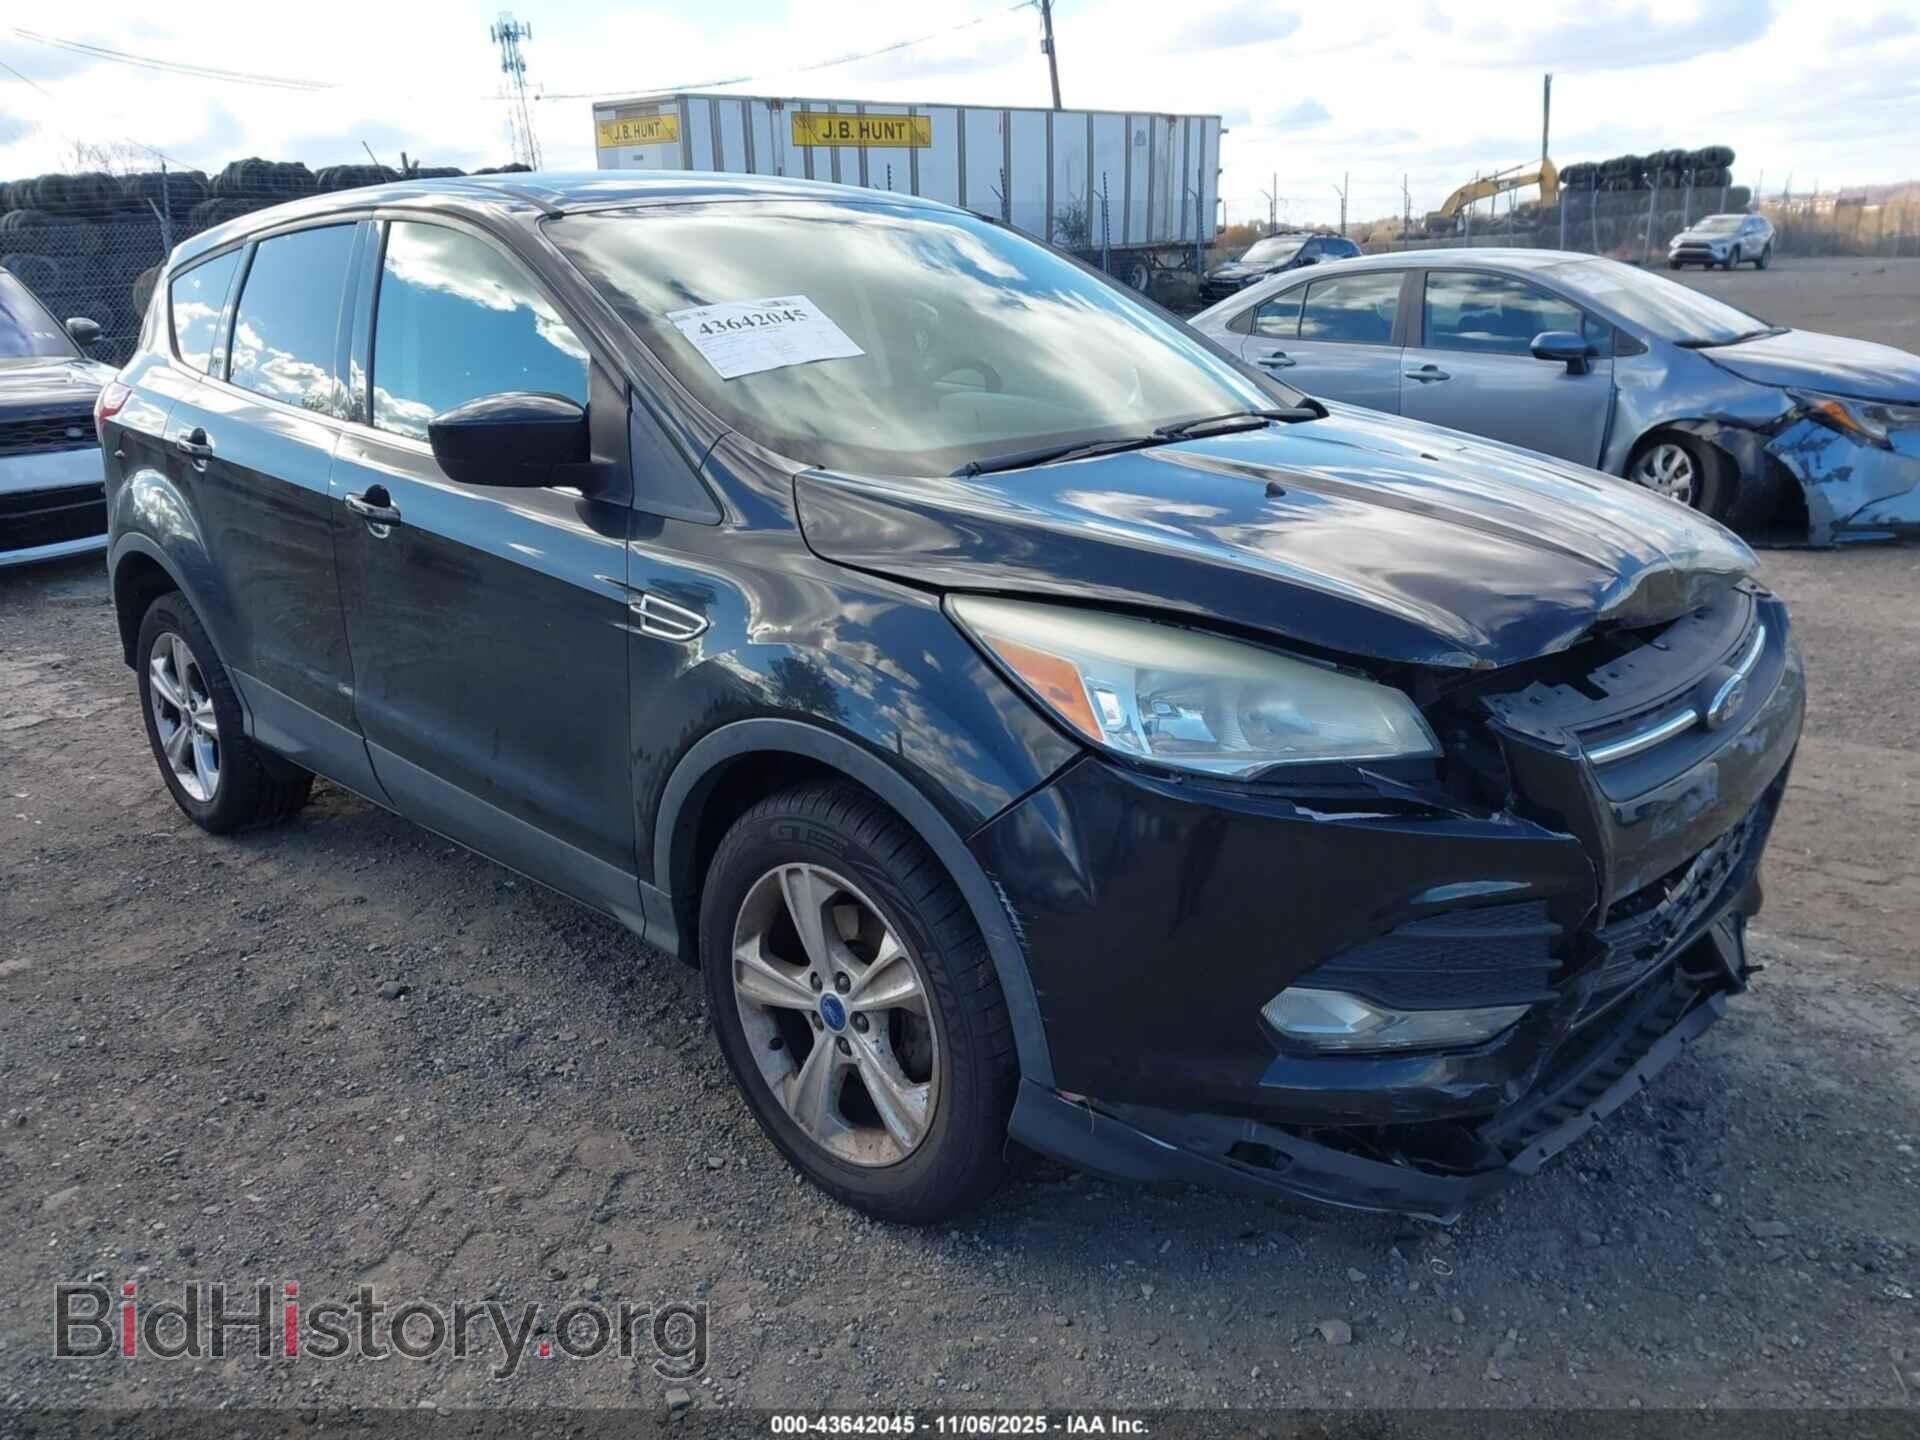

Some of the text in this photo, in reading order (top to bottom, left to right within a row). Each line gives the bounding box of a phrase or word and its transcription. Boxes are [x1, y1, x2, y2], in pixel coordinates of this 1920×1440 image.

[634, 120, 660, 138] HUNT
[822, 121, 905, 140] J.B. HUNT
[700, 308, 808, 335] 43642045
